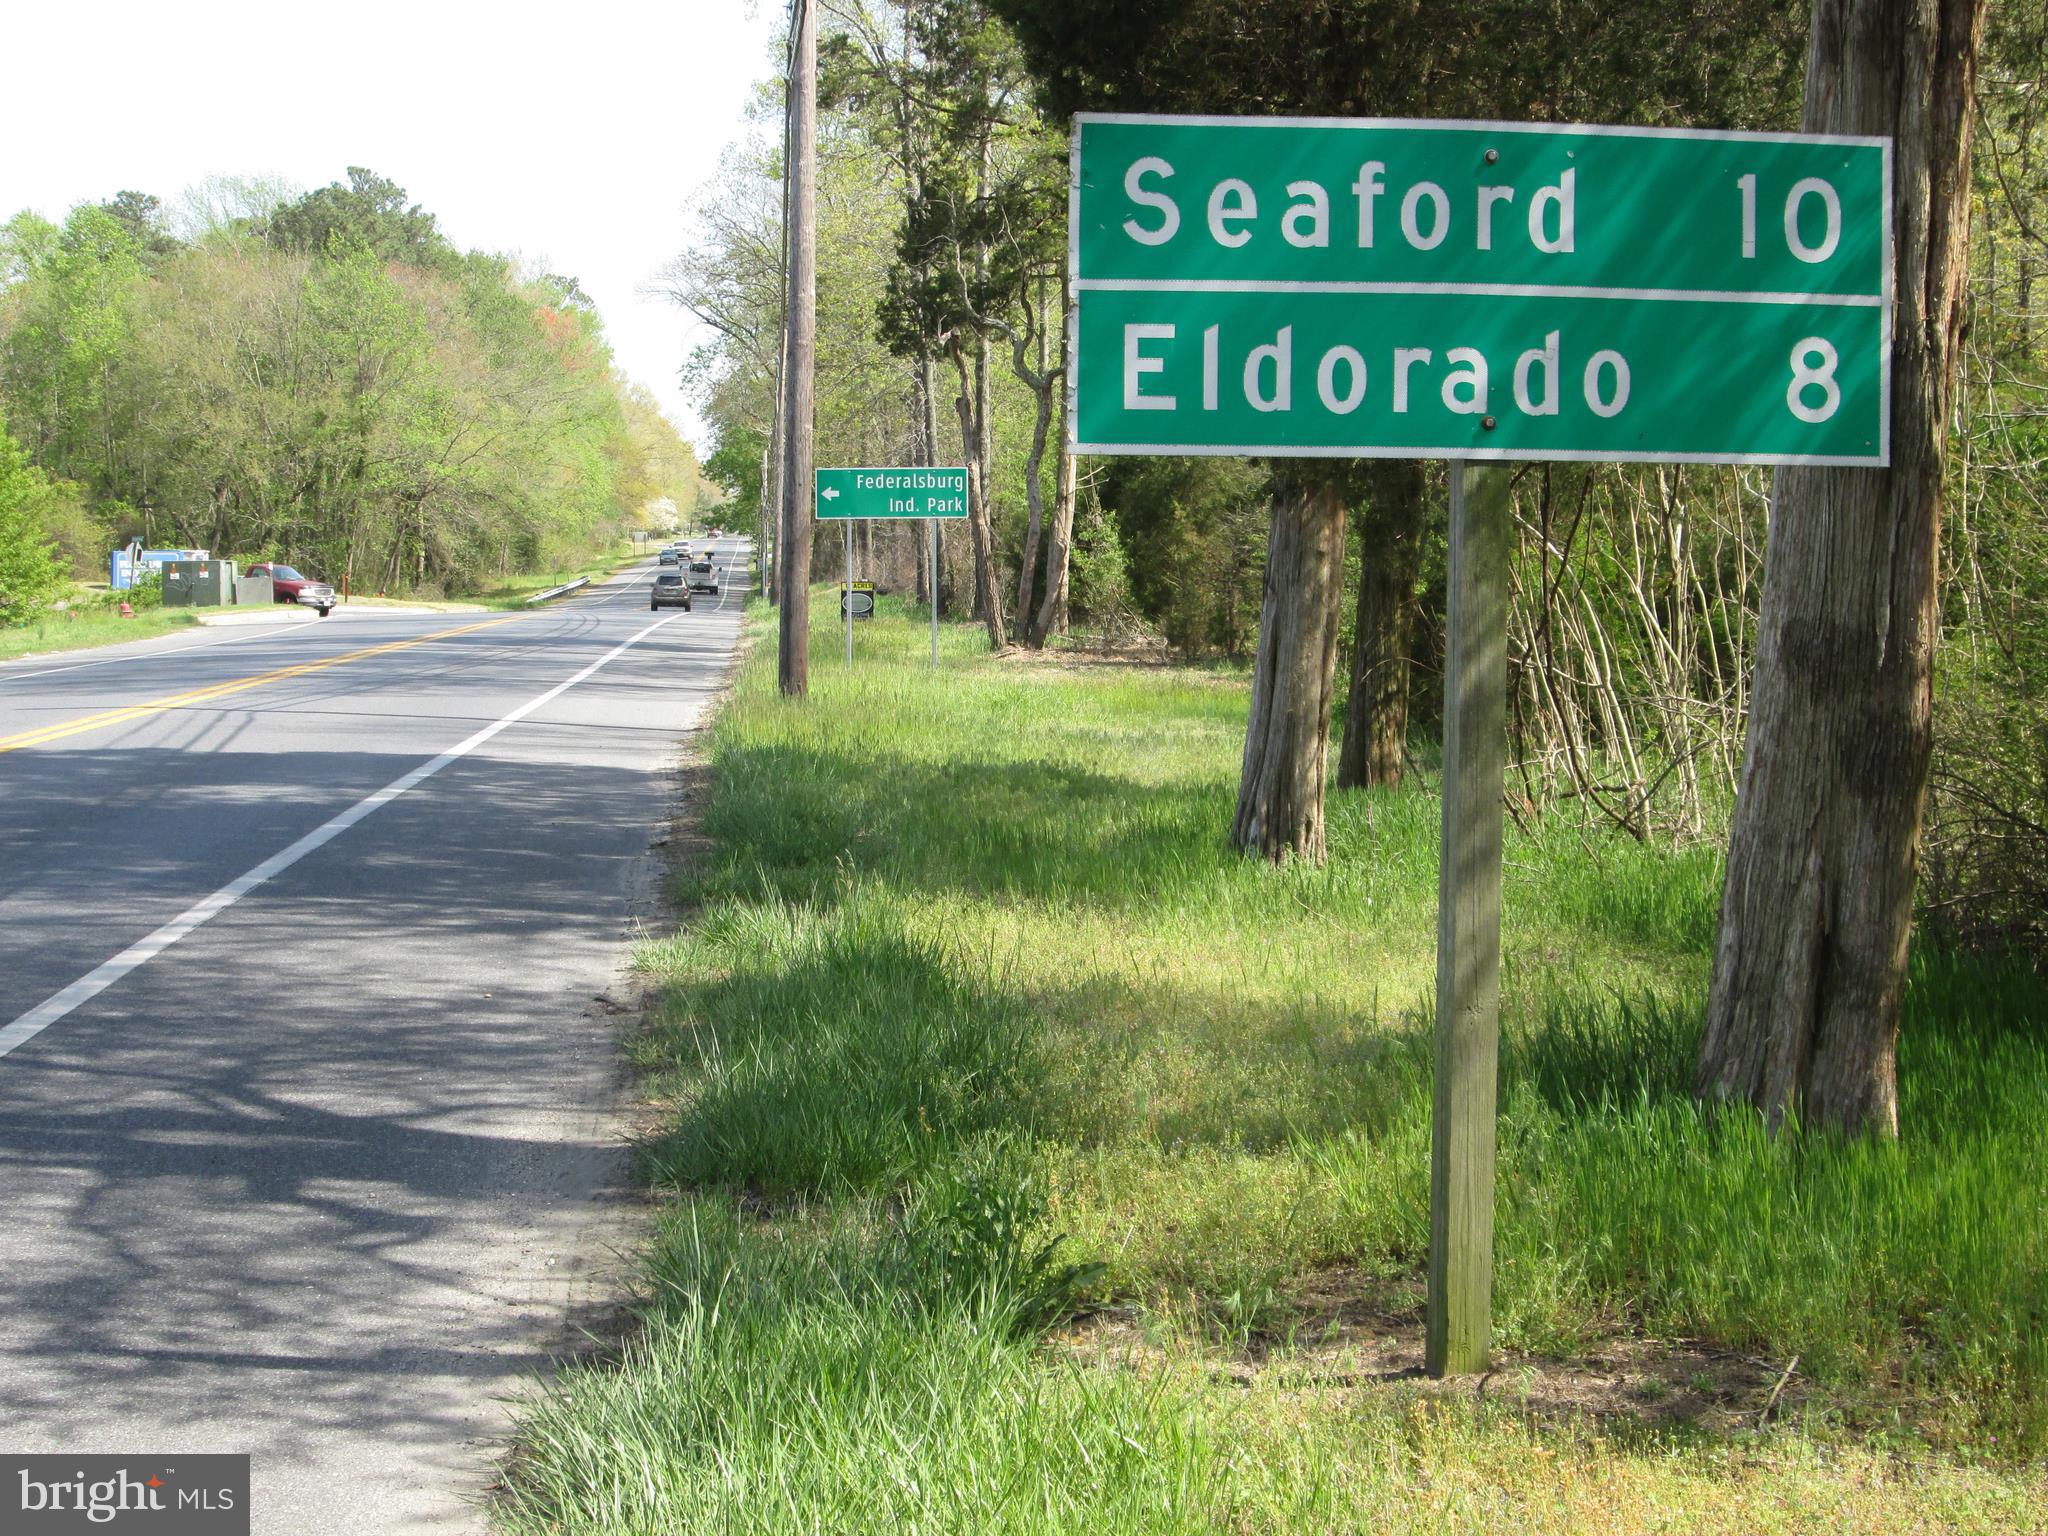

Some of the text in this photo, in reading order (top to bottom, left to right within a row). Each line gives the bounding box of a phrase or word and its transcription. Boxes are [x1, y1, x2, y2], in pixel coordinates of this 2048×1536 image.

[1123, 156, 1842, 264] Seaford 10
[1123, 323, 1841, 424] Eldorado 8
[857, 473, 963, 492] Federalsburg
[889, 497, 963, 512] Ind. Park
